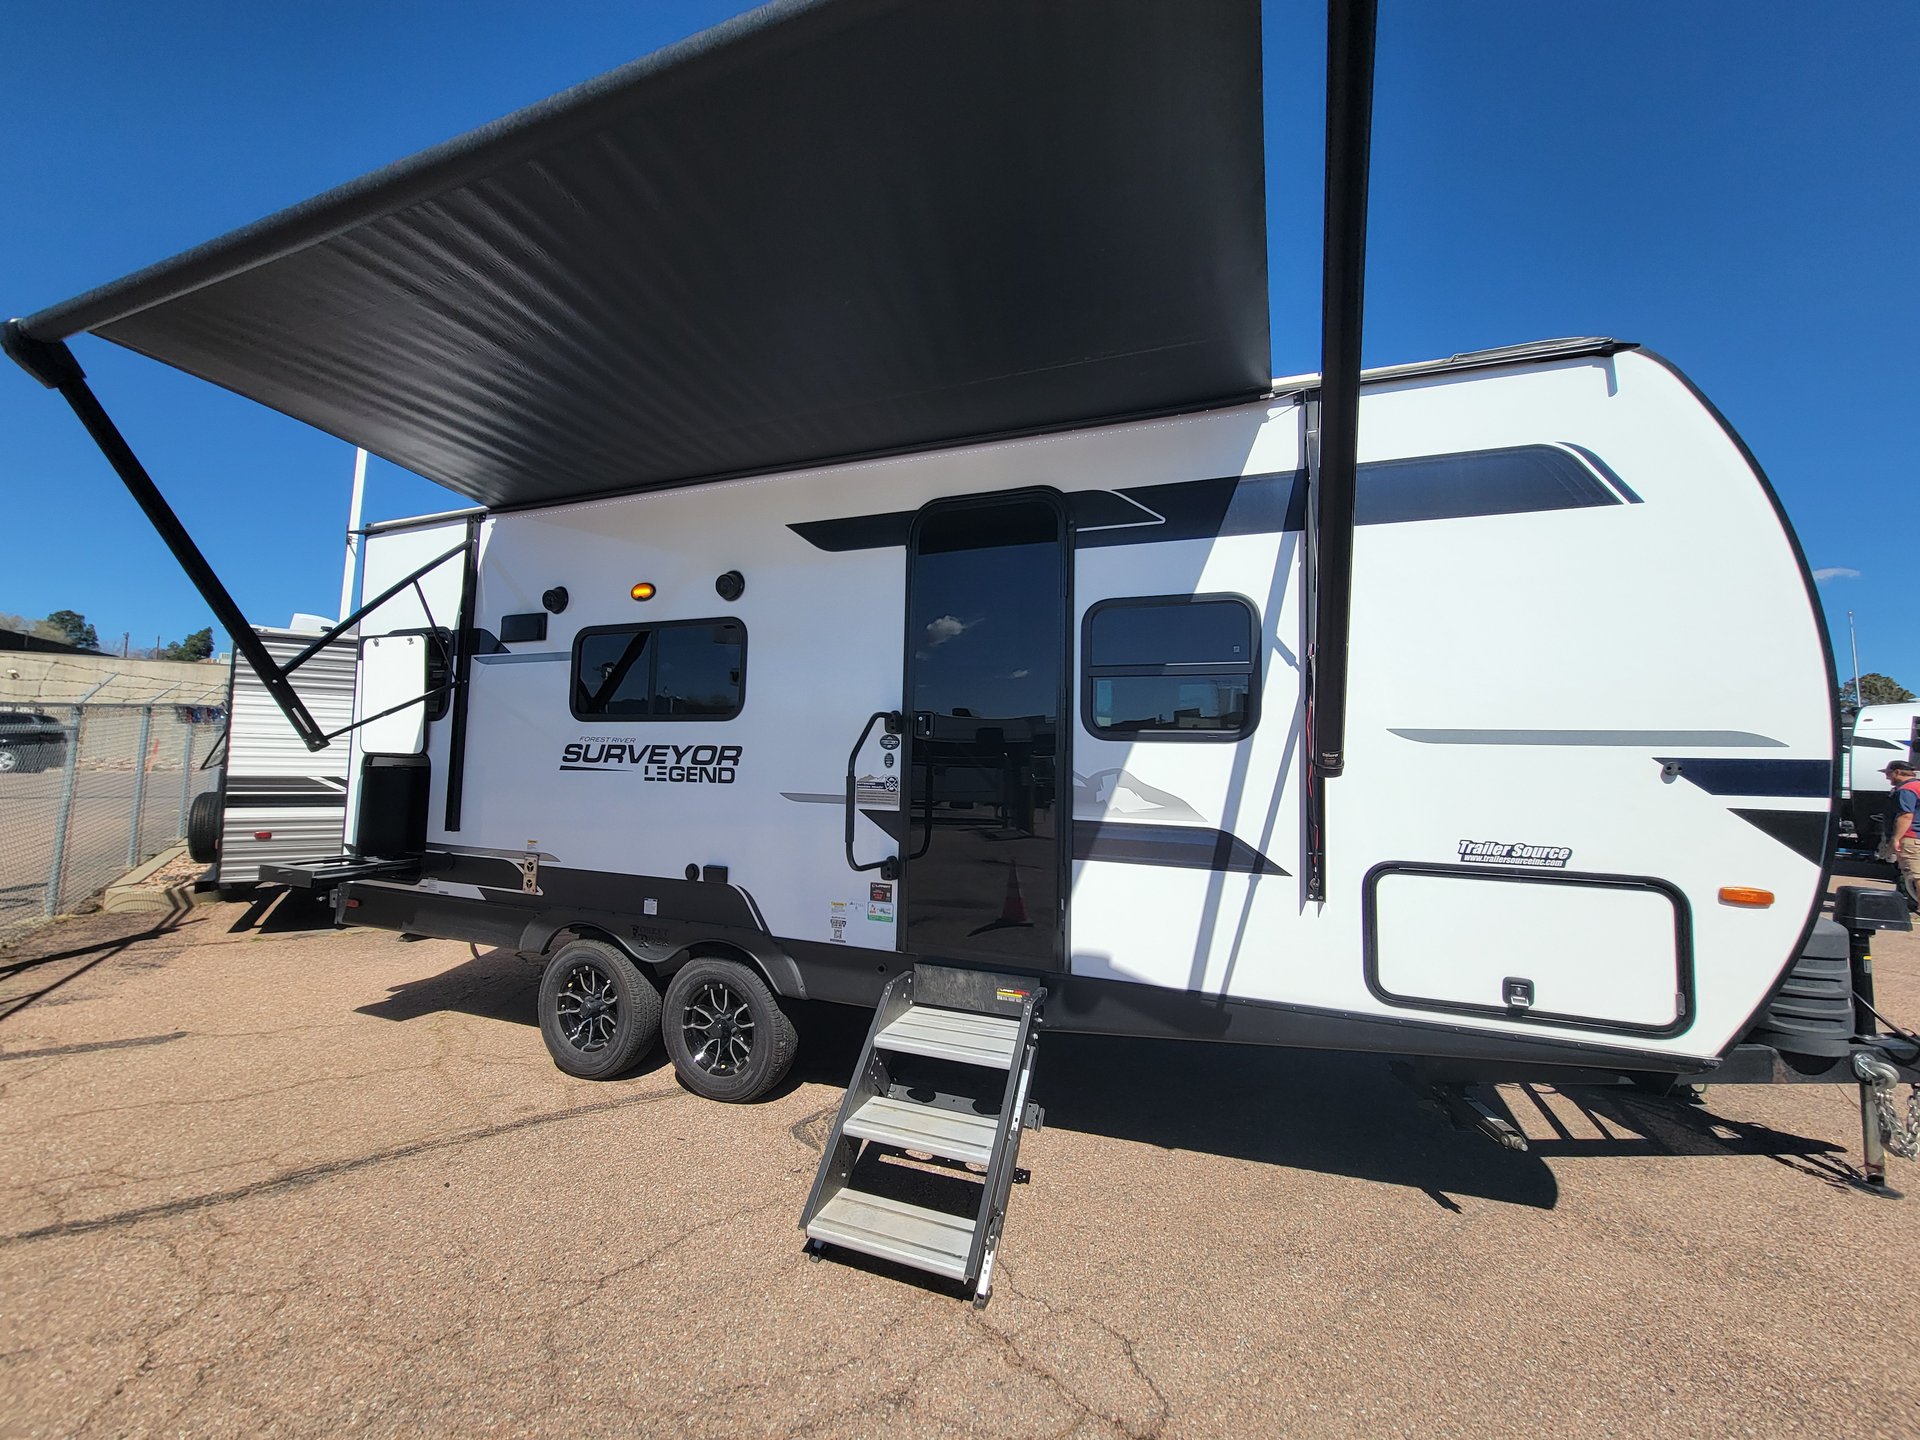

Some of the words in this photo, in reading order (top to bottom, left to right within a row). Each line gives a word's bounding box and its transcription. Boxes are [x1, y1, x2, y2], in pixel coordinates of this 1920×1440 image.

[562, 743, 743, 766] SURVEYOR
[644, 765, 736, 784] LEGEND
[1458, 840, 1511, 857] Trailer
[1511, 842, 1573, 861] Source
[1462, 853, 1565, 868] www.trailersourceinc.com
